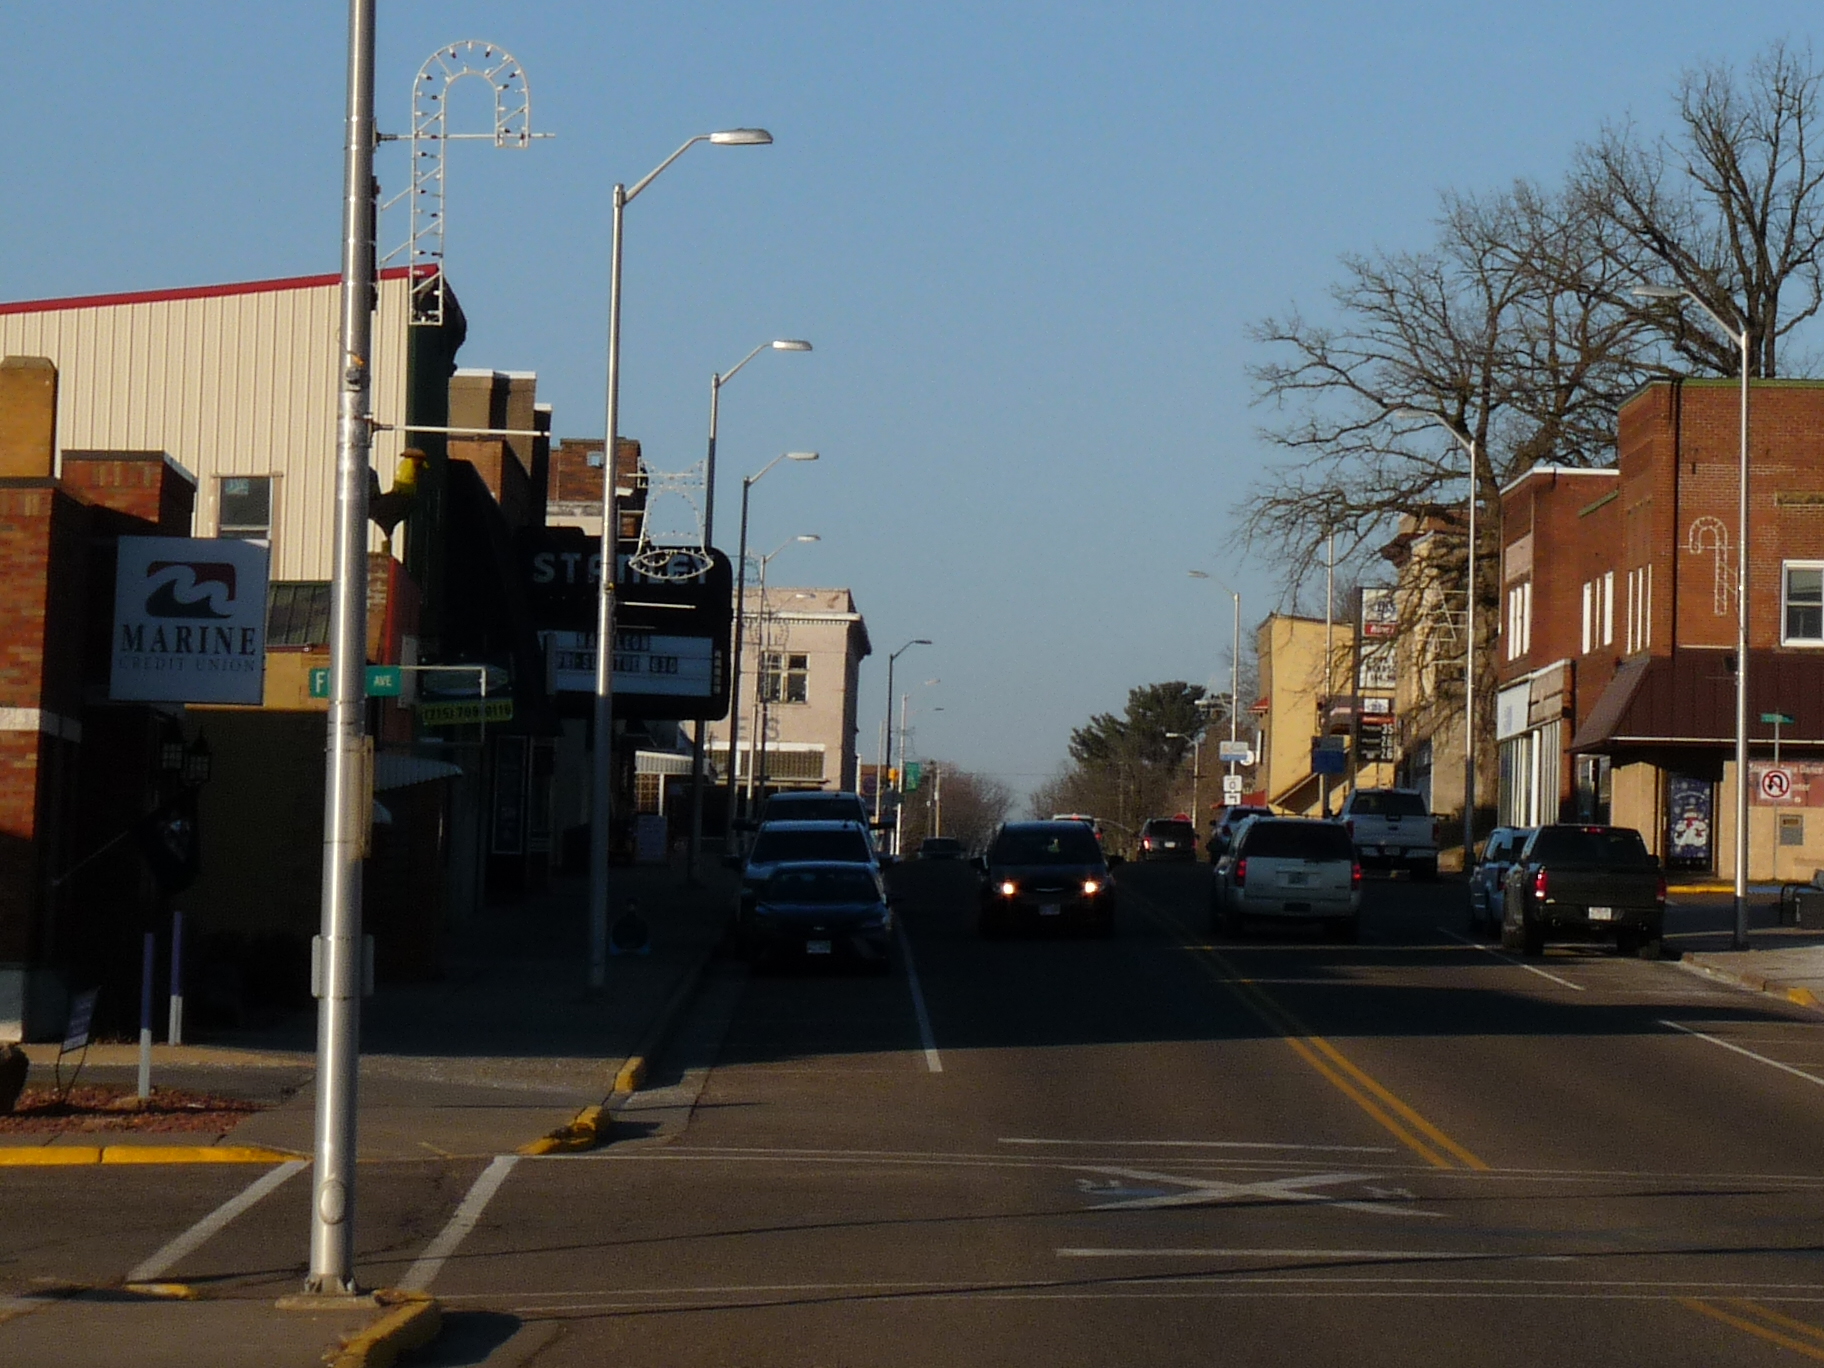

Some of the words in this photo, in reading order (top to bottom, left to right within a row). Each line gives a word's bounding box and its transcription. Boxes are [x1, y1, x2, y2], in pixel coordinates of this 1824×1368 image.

[120, 624, 256, 656] MARINE
[118, 653, 184, 671] CREDIT
[196, 656, 255, 672] UNION
[374, 675, 392, 687] AVE
